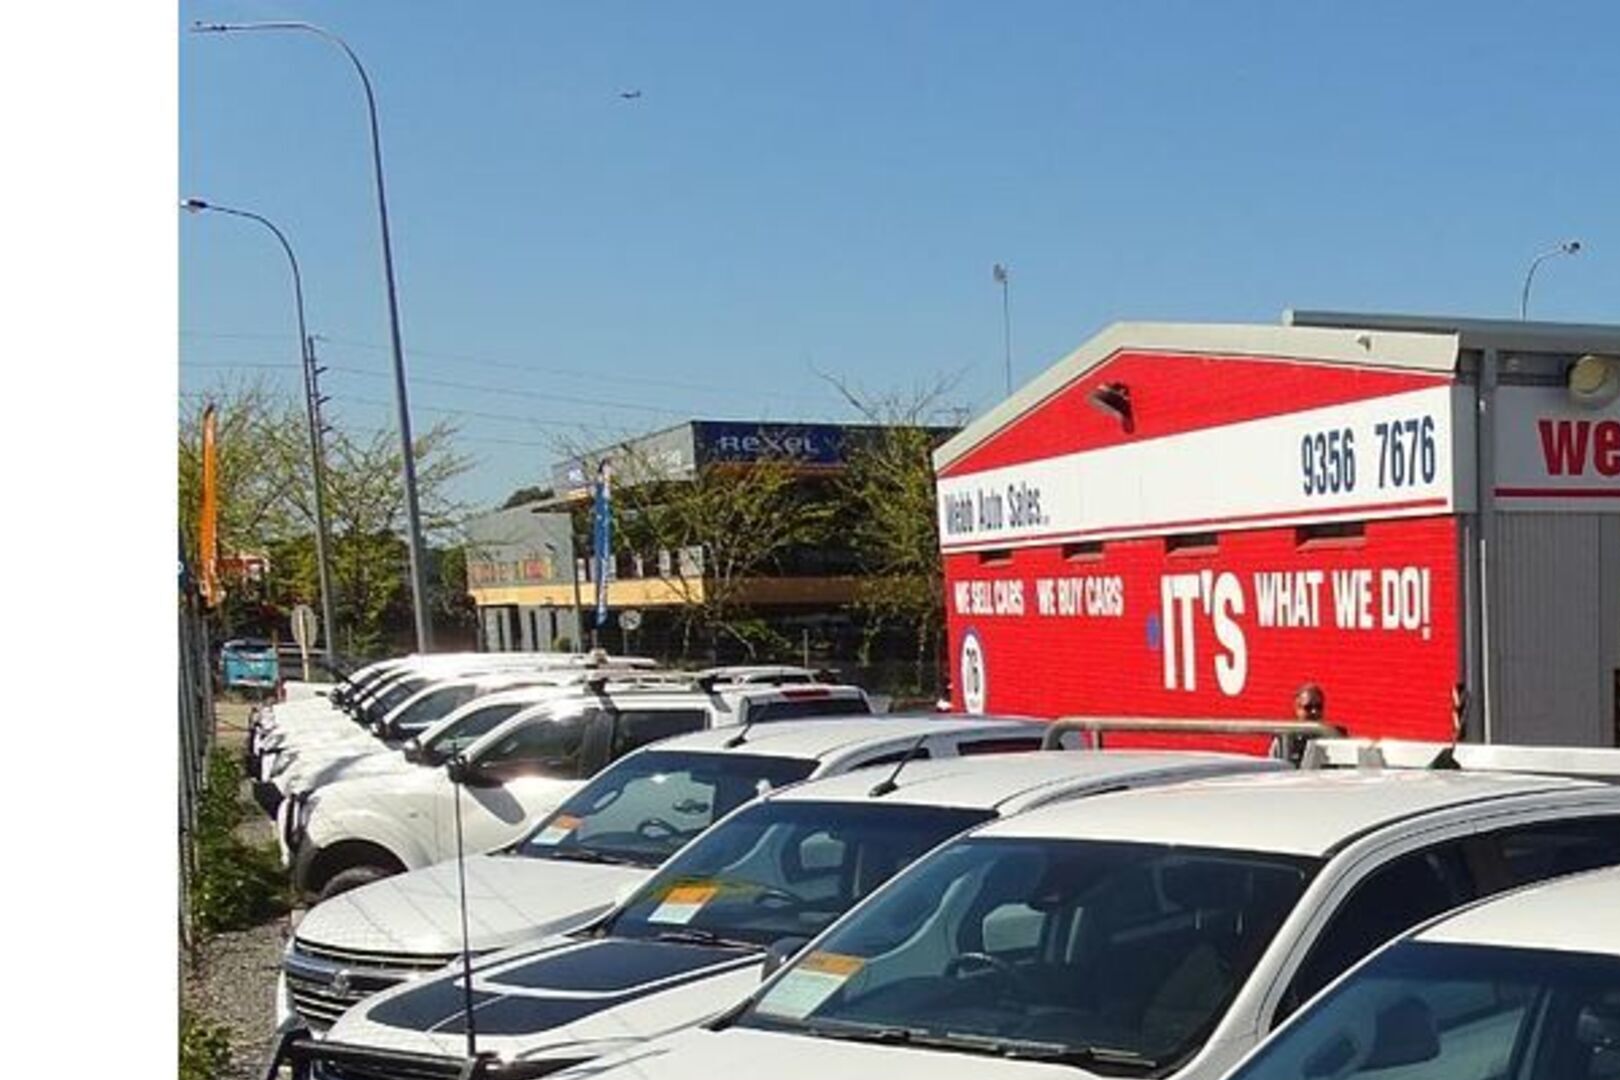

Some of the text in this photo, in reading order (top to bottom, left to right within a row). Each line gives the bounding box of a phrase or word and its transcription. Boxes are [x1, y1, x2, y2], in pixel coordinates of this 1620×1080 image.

[1302, 415, 1436, 496] 9356 7676
[945, 482, 1041, 535] Webb Auto Sales
[955, 579, 1025, 616] WE SELL CARS
[1036, 575, 1124, 617] WE BUY CARS
[1161, 567, 1431, 696] IT'S WHAT WE DO!
